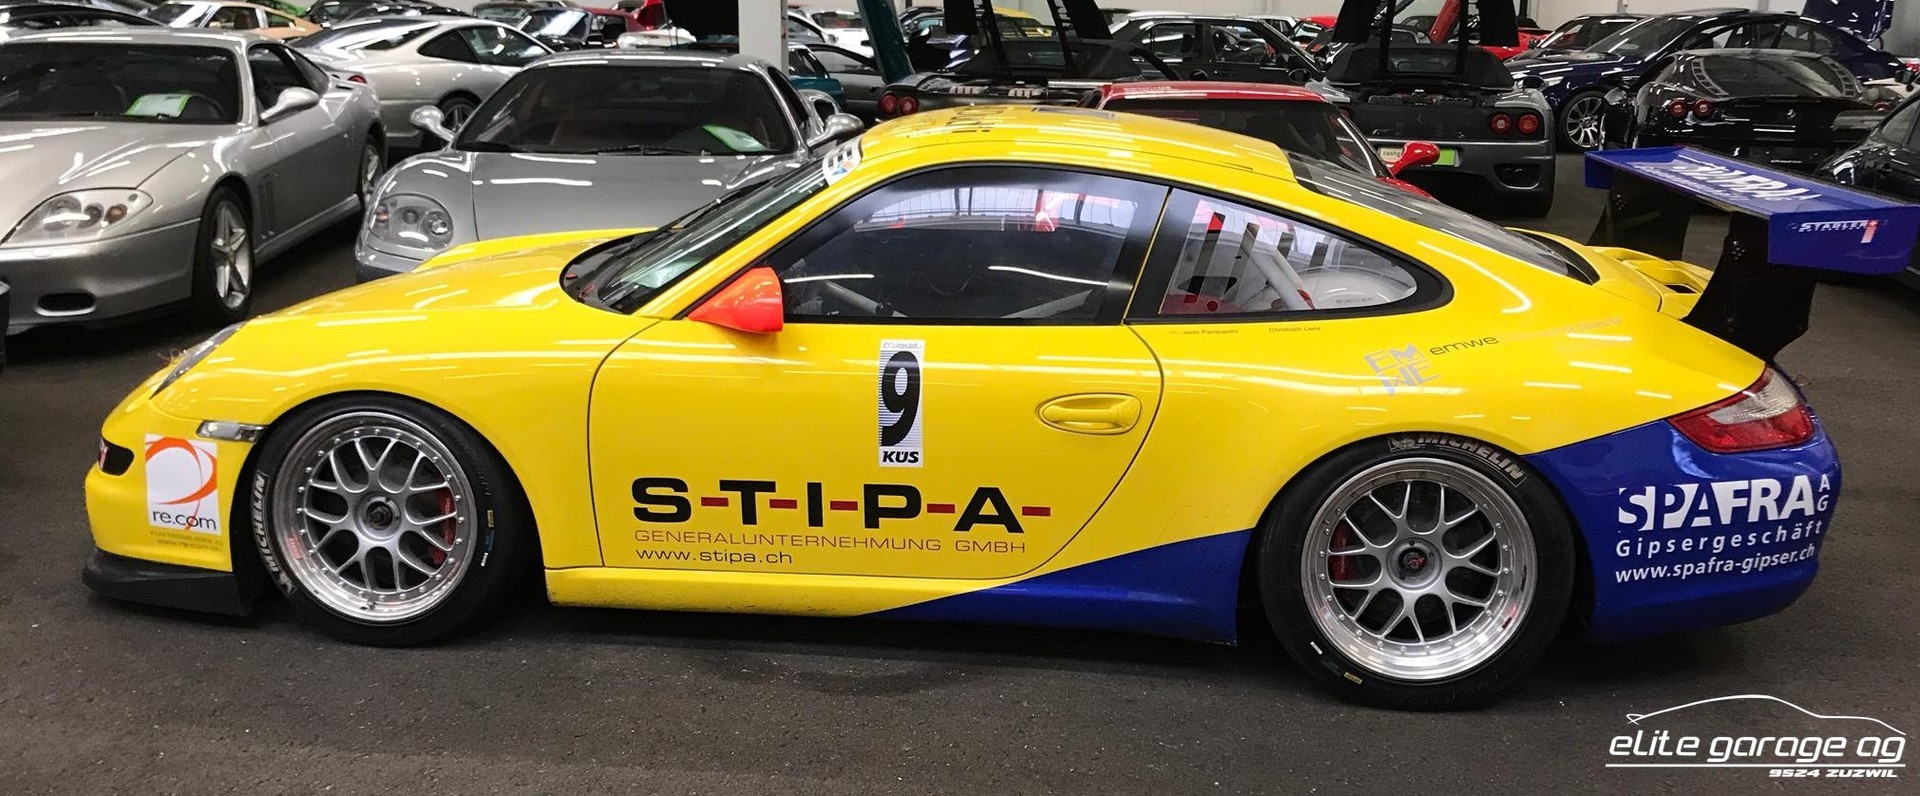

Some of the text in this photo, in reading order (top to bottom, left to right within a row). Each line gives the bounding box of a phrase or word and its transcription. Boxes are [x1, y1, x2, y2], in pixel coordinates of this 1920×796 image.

[1429, 336, 1500, 356] emwe
[881, 350, 921, 447] 9
[881, 450, 919, 464] KÜS
[1417, 433, 1524, 480] MICHELIN
[152, 510, 217, 531] re.com
[252, 473, 281, 574] MICHELIN
[1618, 475, 1816, 532] SPAFRA
[634, 530, 1026, 554] GENERALUNTERNEHMUNG GMBH
[635, 549, 793, 565] www.stipa.ch
[1615, 519, 1823, 559] Gipsergeschäft
[1615, 543, 1816, 583] www.spafra-gipser.ch
